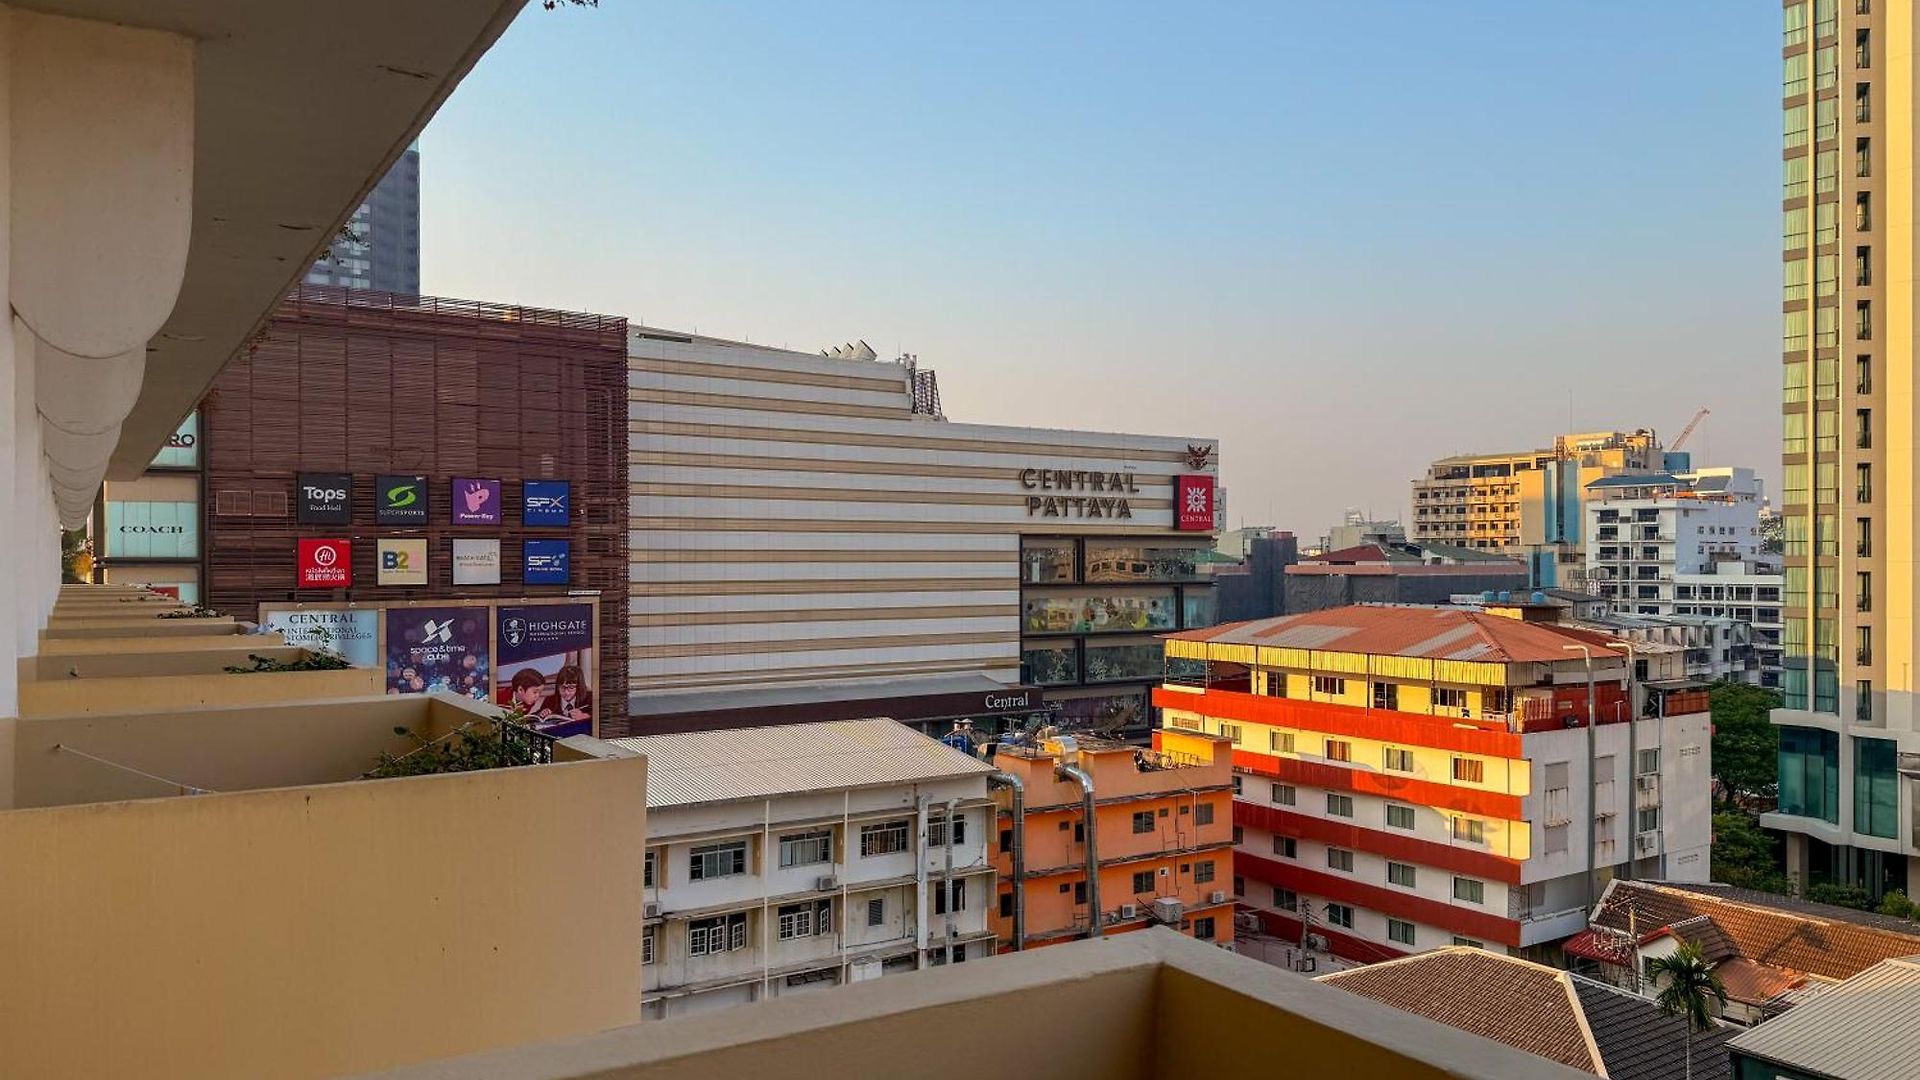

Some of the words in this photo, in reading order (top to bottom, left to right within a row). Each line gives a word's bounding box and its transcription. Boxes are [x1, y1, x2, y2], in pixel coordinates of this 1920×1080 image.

[1019, 468, 1140, 494] CENTRAL
[303, 486, 347, 503] Tops
[526, 495, 566, 508] SFX
[1026, 496, 1132, 519] PATTAYA
[1180, 515, 1212, 523] CENTRAL
[119, 525, 183, 534] COACH
[289, 614, 357, 624] CENTRAL
[529, 620, 587, 631] HIGHGATE
[985, 691, 1029, 710] Central
